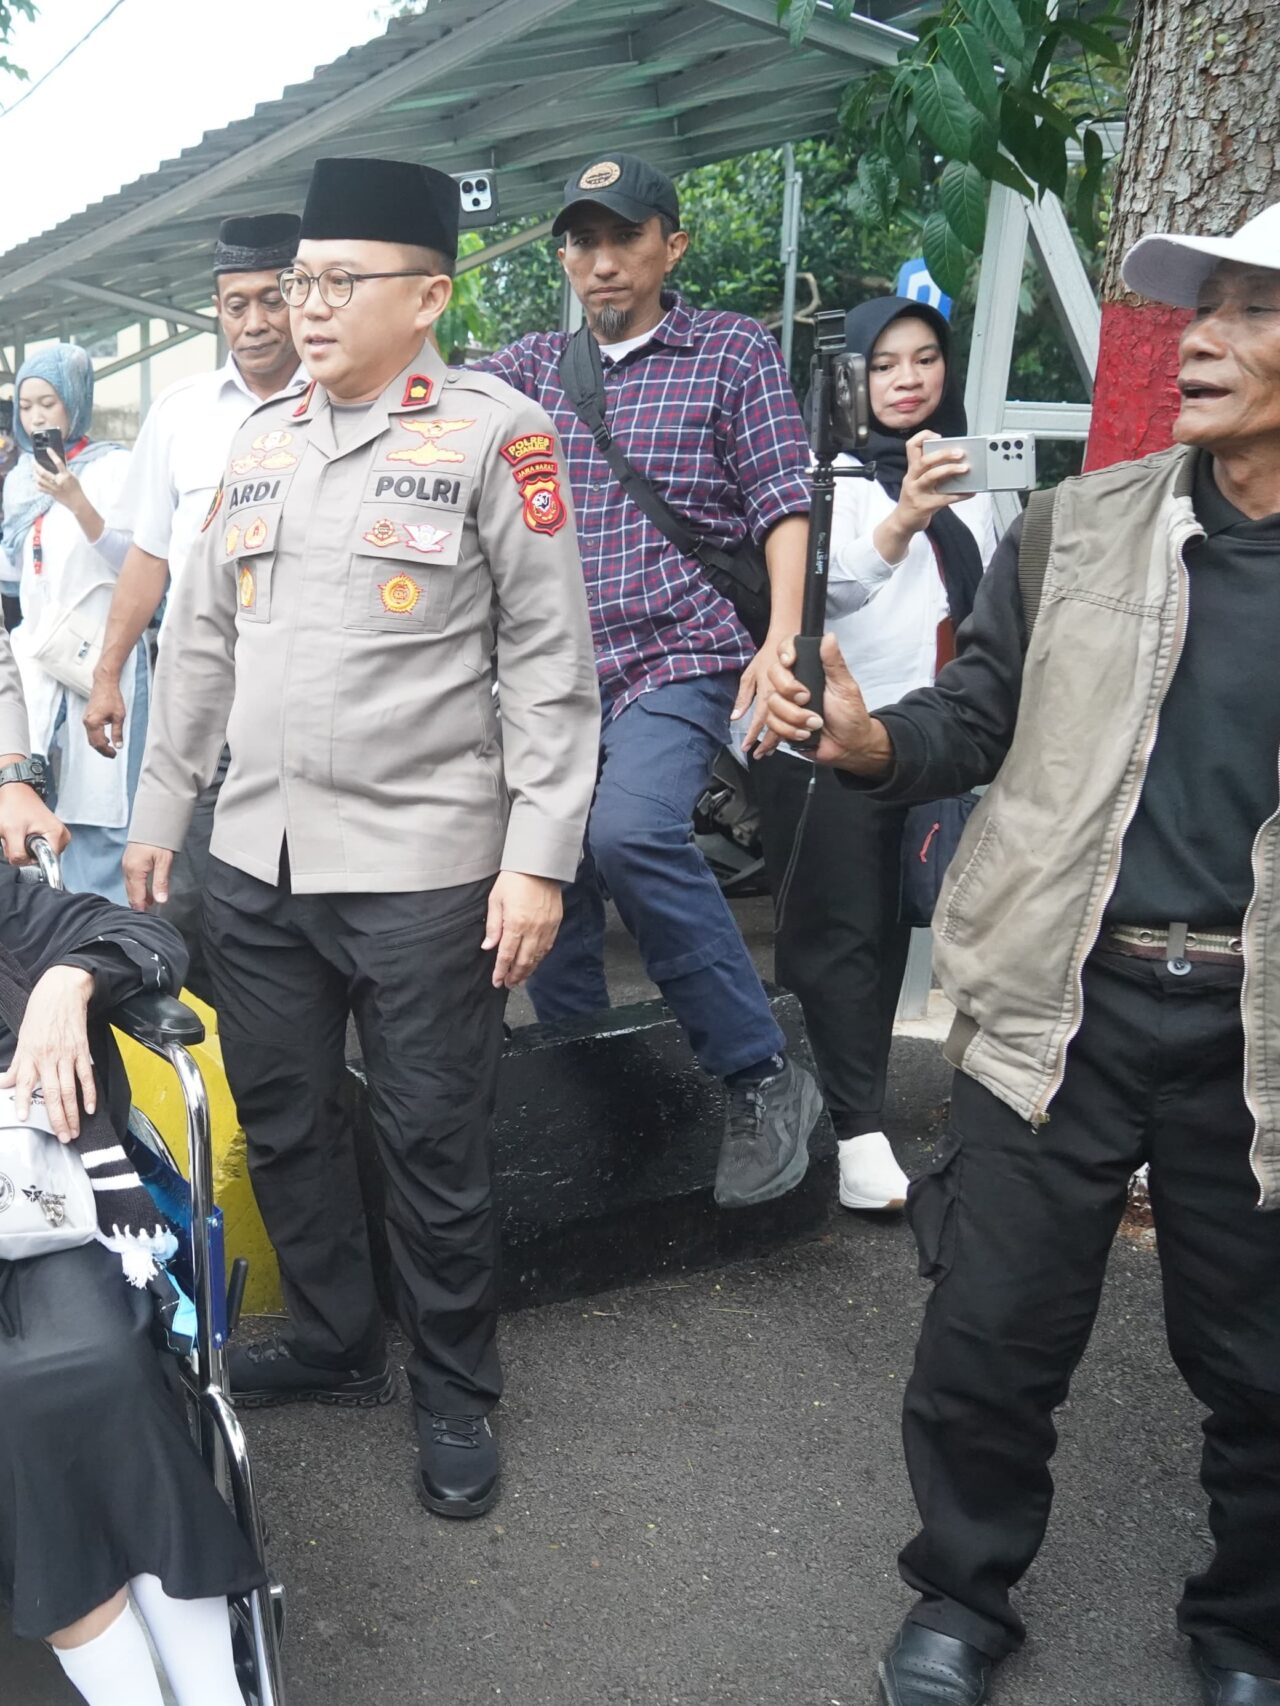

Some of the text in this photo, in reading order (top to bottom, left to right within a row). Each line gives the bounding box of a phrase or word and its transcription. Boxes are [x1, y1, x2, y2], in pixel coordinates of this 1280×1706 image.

[508, 436, 550, 456] POLRES
[229, 475, 461, 510] ARDI POLRI
